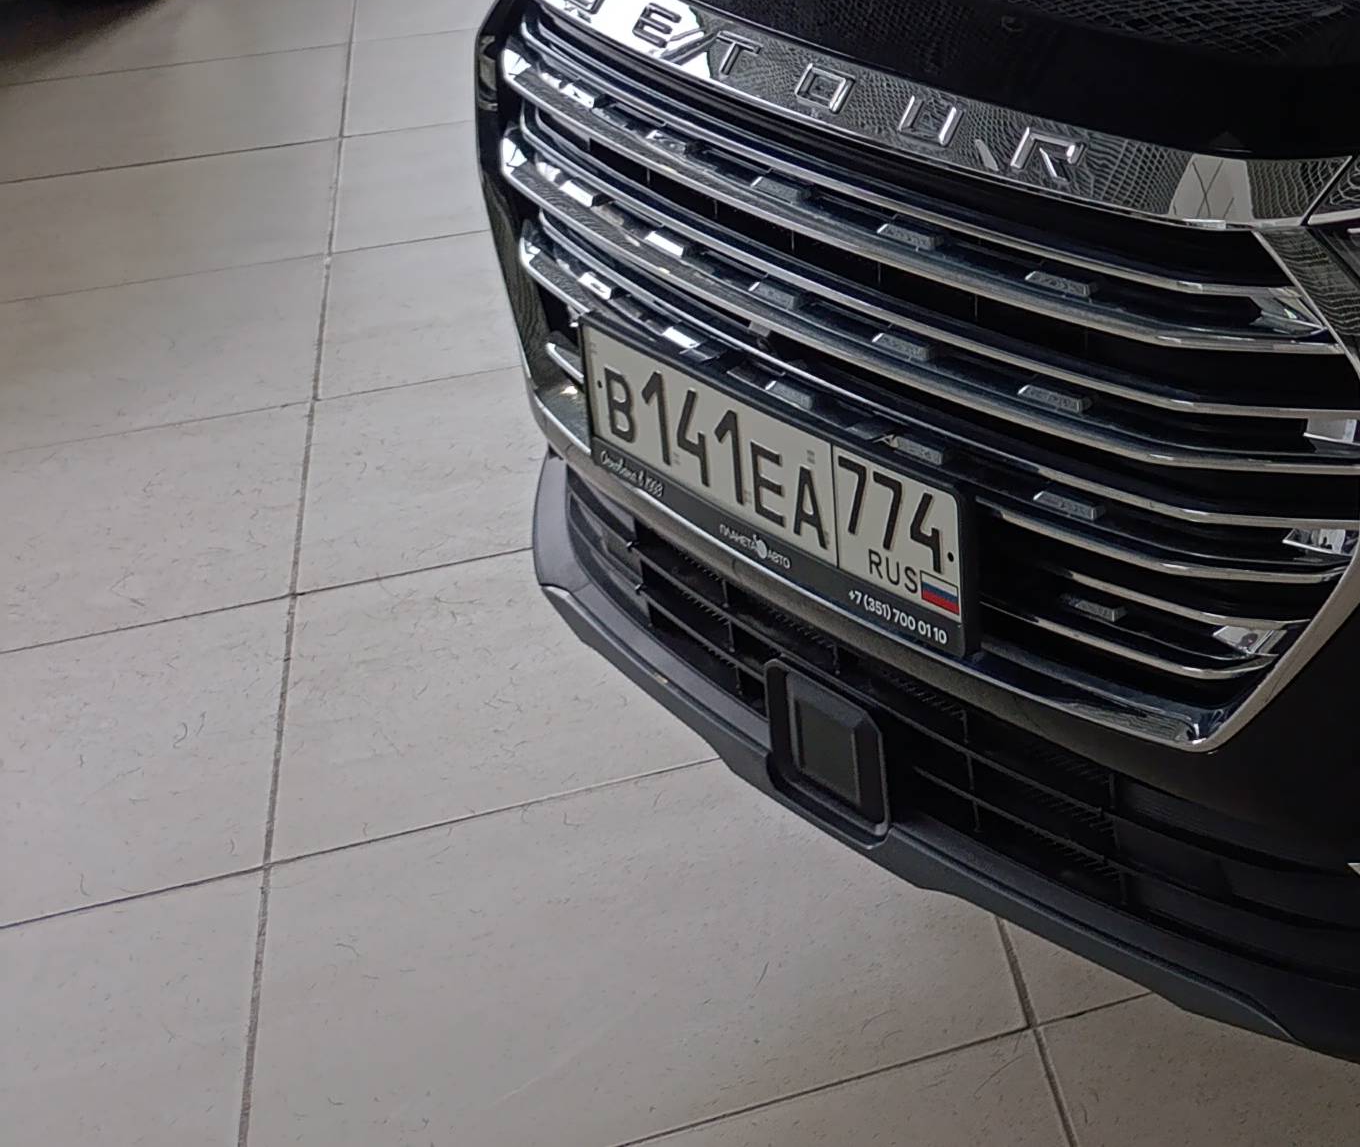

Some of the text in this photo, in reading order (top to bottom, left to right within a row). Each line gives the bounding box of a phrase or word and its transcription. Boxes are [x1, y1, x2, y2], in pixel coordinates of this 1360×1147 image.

[838, 458, 942, 573] 774
[868, 549, 919, 594] RUS
[864, 595, 891, 621] (351)
[893, 608, 916, 630] 700
